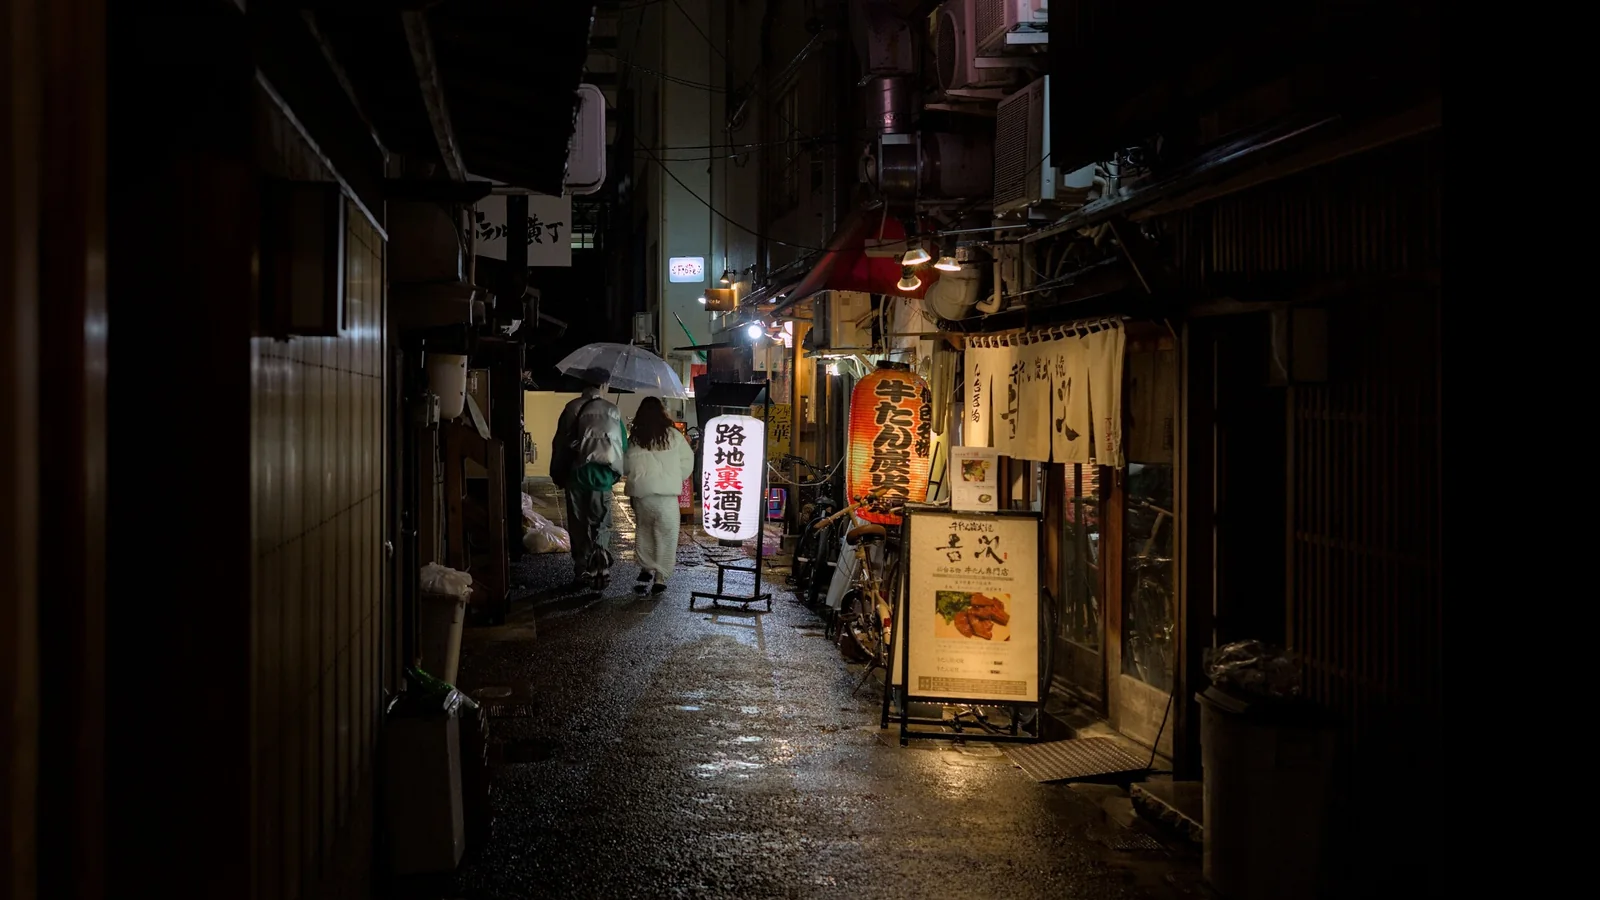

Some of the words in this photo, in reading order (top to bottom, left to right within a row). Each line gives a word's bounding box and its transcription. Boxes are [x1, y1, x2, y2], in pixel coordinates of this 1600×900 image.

[712, 423, 747, 534] 路地裏酒場
